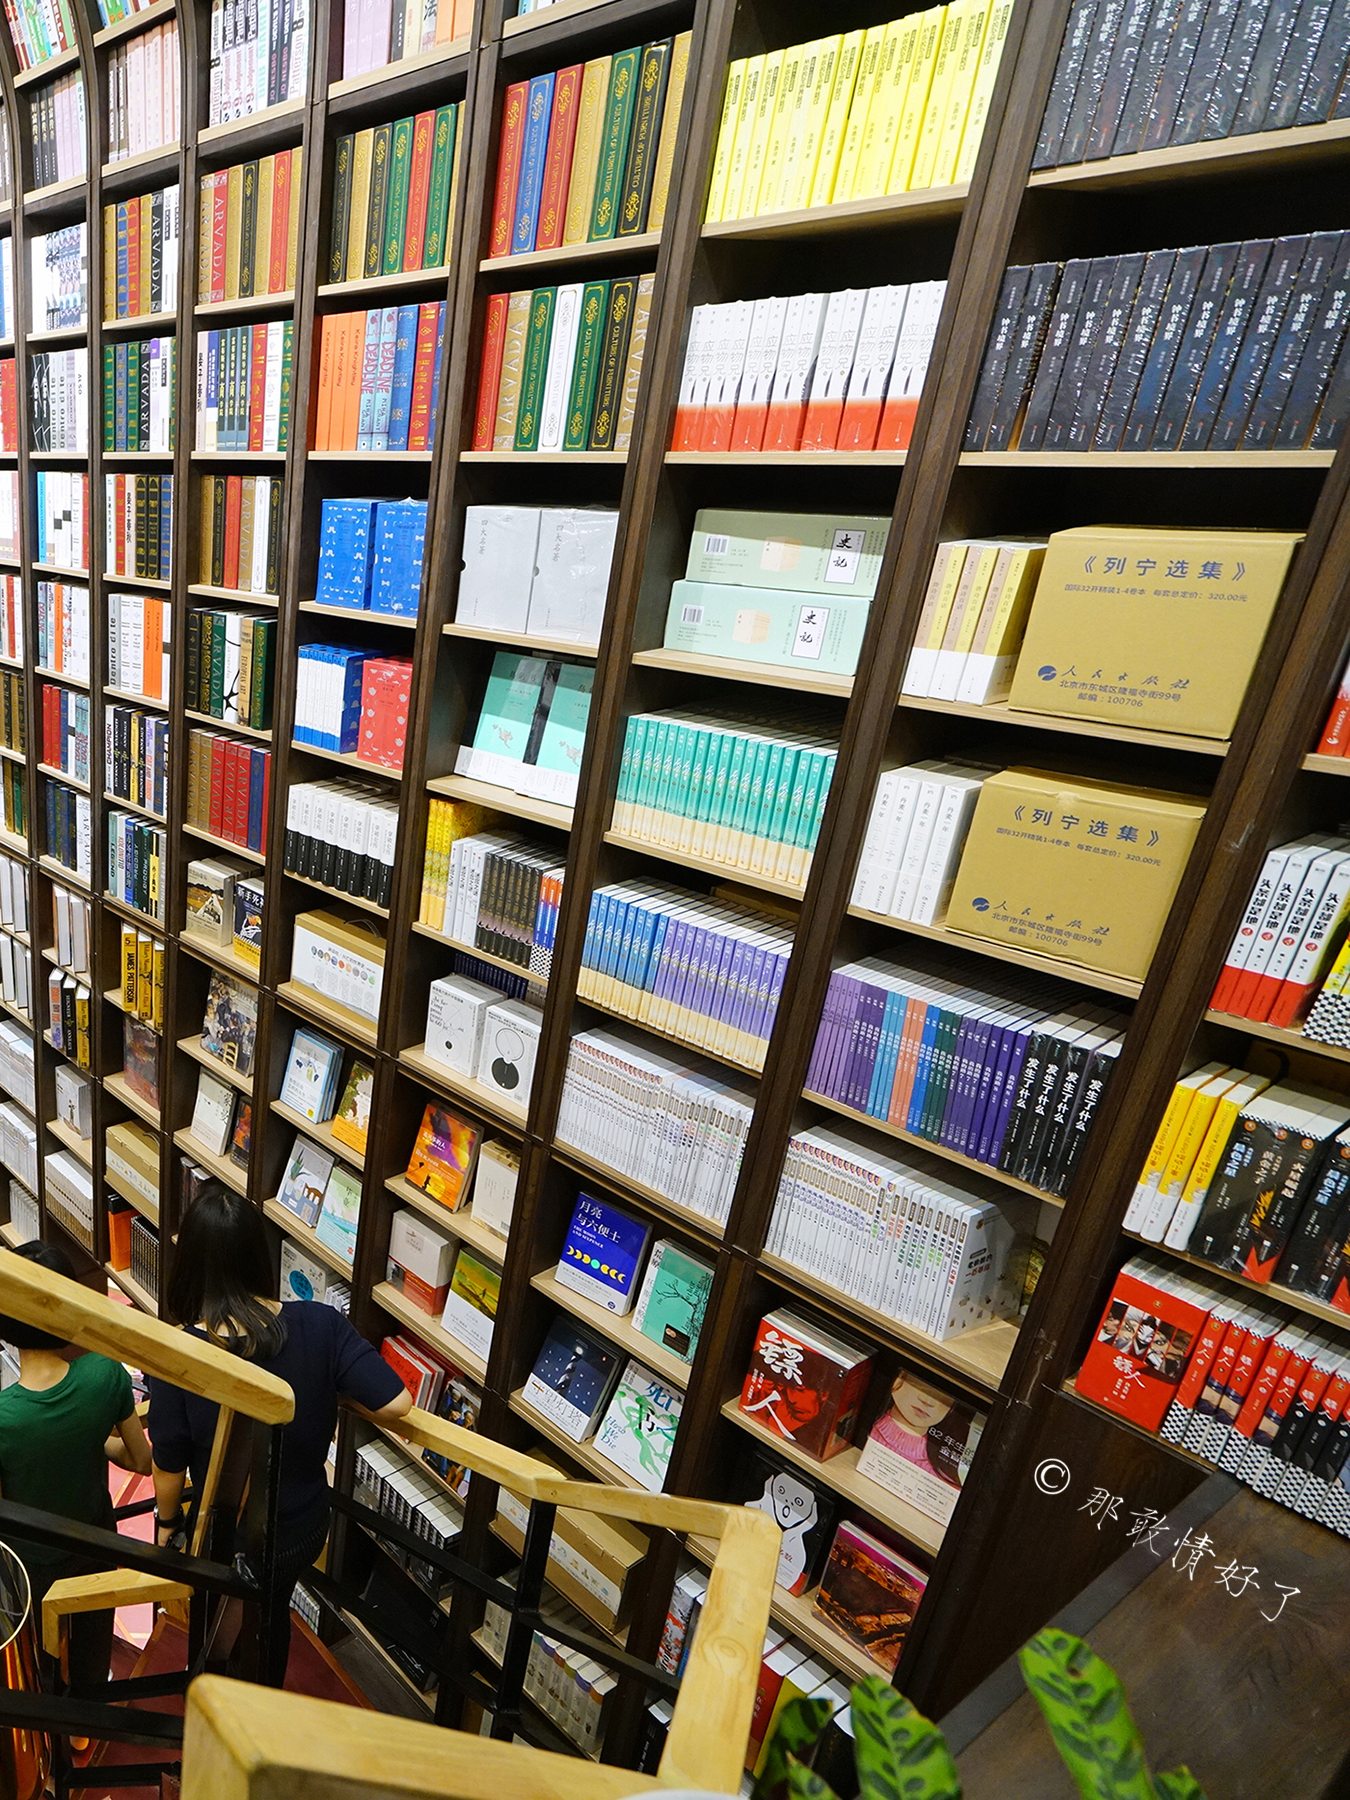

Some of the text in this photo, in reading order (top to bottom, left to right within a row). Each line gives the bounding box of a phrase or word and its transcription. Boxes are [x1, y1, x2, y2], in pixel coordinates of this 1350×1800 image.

[152, 216, 161, 293] ARVADA
[200, 201, 210, 283] ARVADA
[213, 198, 224, 281] ARVADA
[361, 343, 379, 394] DEADLINE
[377, 342, 396, 394] DEADLINE
[499, 320, 524, 423] ARVADA
[622, 309, 650, 422] ARVADA
[141, 360, 151, 433] ARVADA
[240, 500, 249, 572] ARVADA
[833, 534, 852, 568] 史记
[1084, 557, 1246, 582] 《列宁选集》
[800, 611, 817, 643] 史记
[211, 633, 221, 705] ARVADA
[1061, 665, 1190, 690] 人民出版社
[211, 756, 221, 825] ARVADA
[223, 761, 235, 826] ARVADA
[236, 765, 246, 829] ARVADA
[1014, 804, 1159, 847] 《列宁选集》
[994, 901, 1111, 936] 人民出版社
[127, 972, 135, 1003] PATTERSON
[1017, 1057, 1039, 1109] 发生了什么
[1035, 1064, 1059, 1116] 发生了什么
[1054, 1071, 1079, 1124] 发生了什么
[1076, 1080, 1103, 1132] 发生了什么
[576, 1213, 621, 1243] 与六便士
[579, 1201, 602, 1220] 月亮
[1113, 1355, 1146, 1388] 镖人
[601, 1434, 617, 1450] Die
[605, 1415, 627, 1435] How
[606, 1428, 619, 1440] We
[928, 1426, 943, 1440] 82
